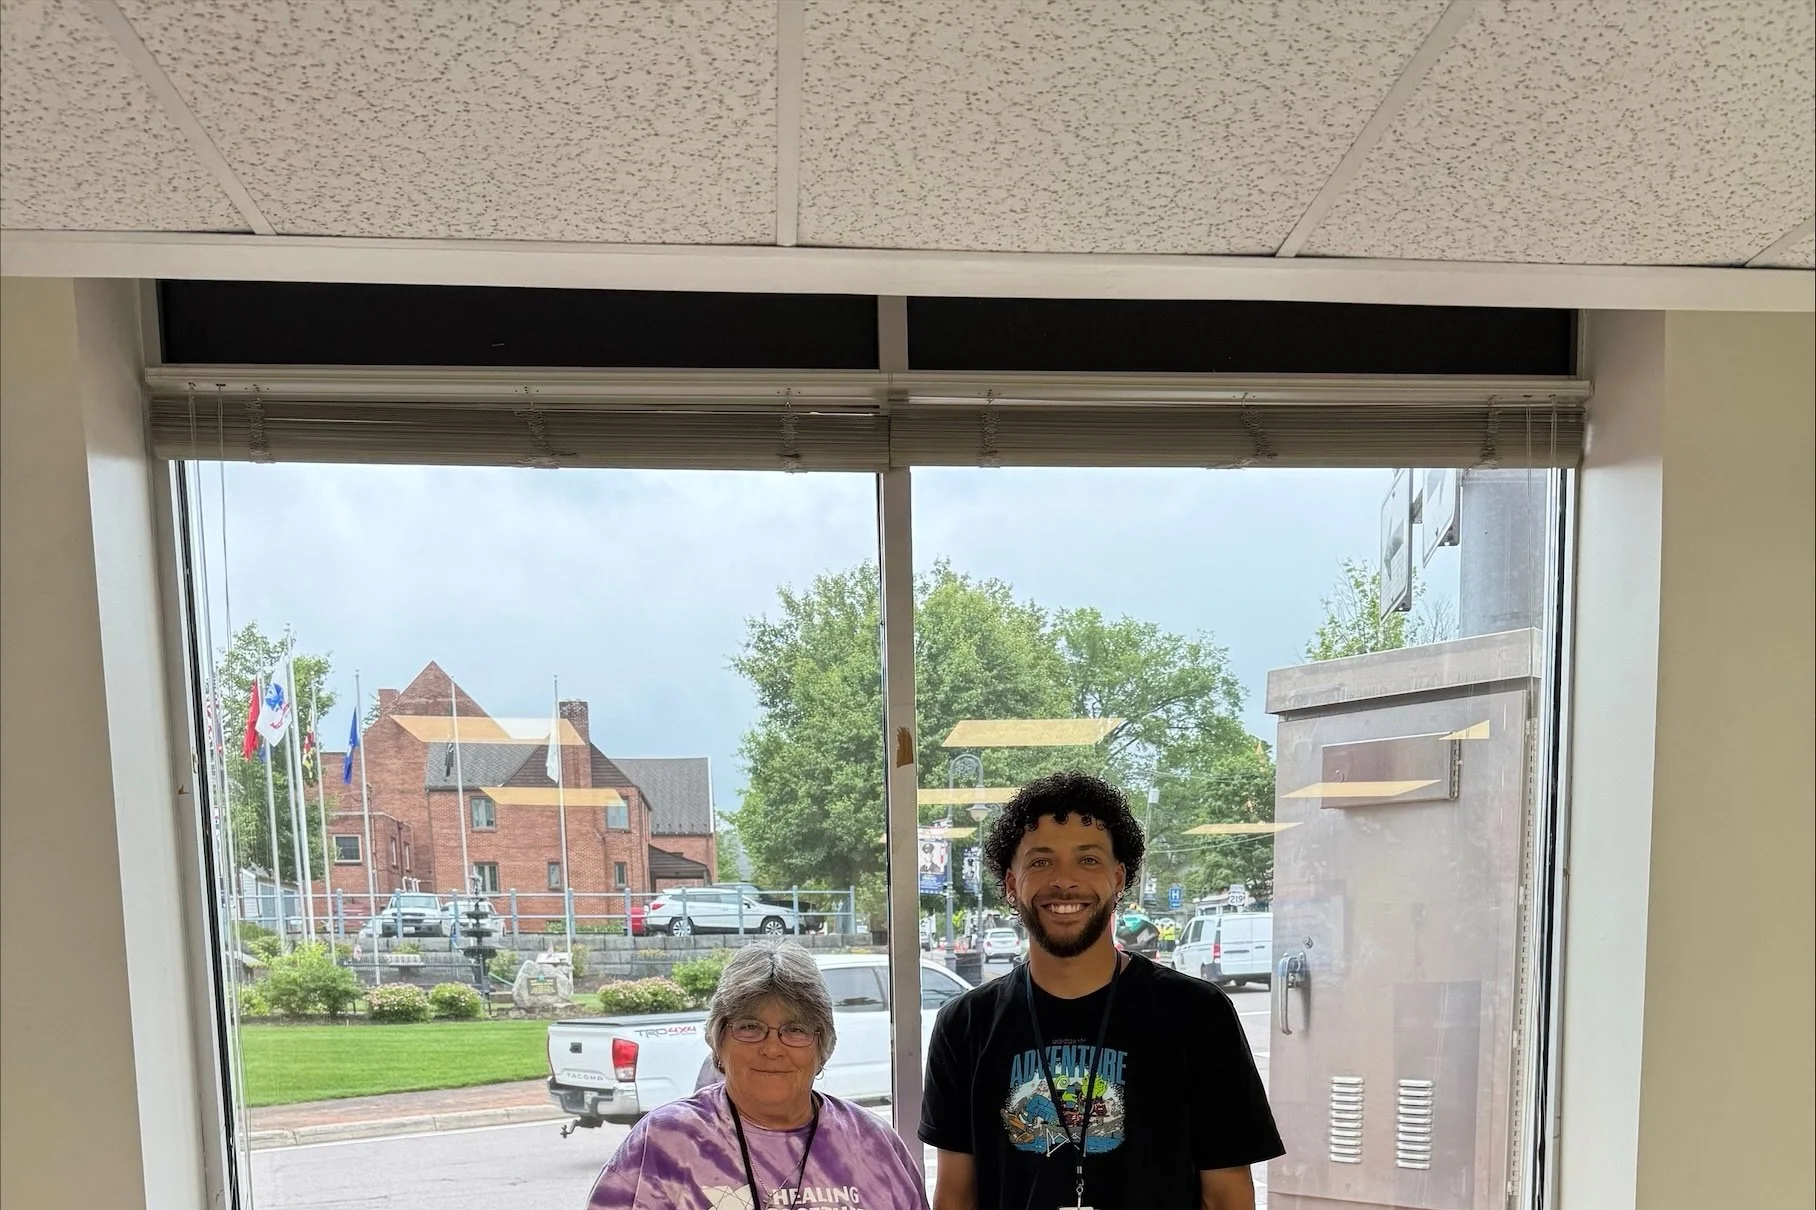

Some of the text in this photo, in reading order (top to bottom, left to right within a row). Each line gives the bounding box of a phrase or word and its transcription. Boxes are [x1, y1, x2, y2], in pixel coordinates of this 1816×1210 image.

[1172, 889, 1180, 900] H
[1229, 895, 1243, 904] 219
[1010, 1045, 1128, 1089] ADVENTURE
[566, 1072, 604, 1081] TACOMA
[773, 1186, 860, 1205] HEALING
